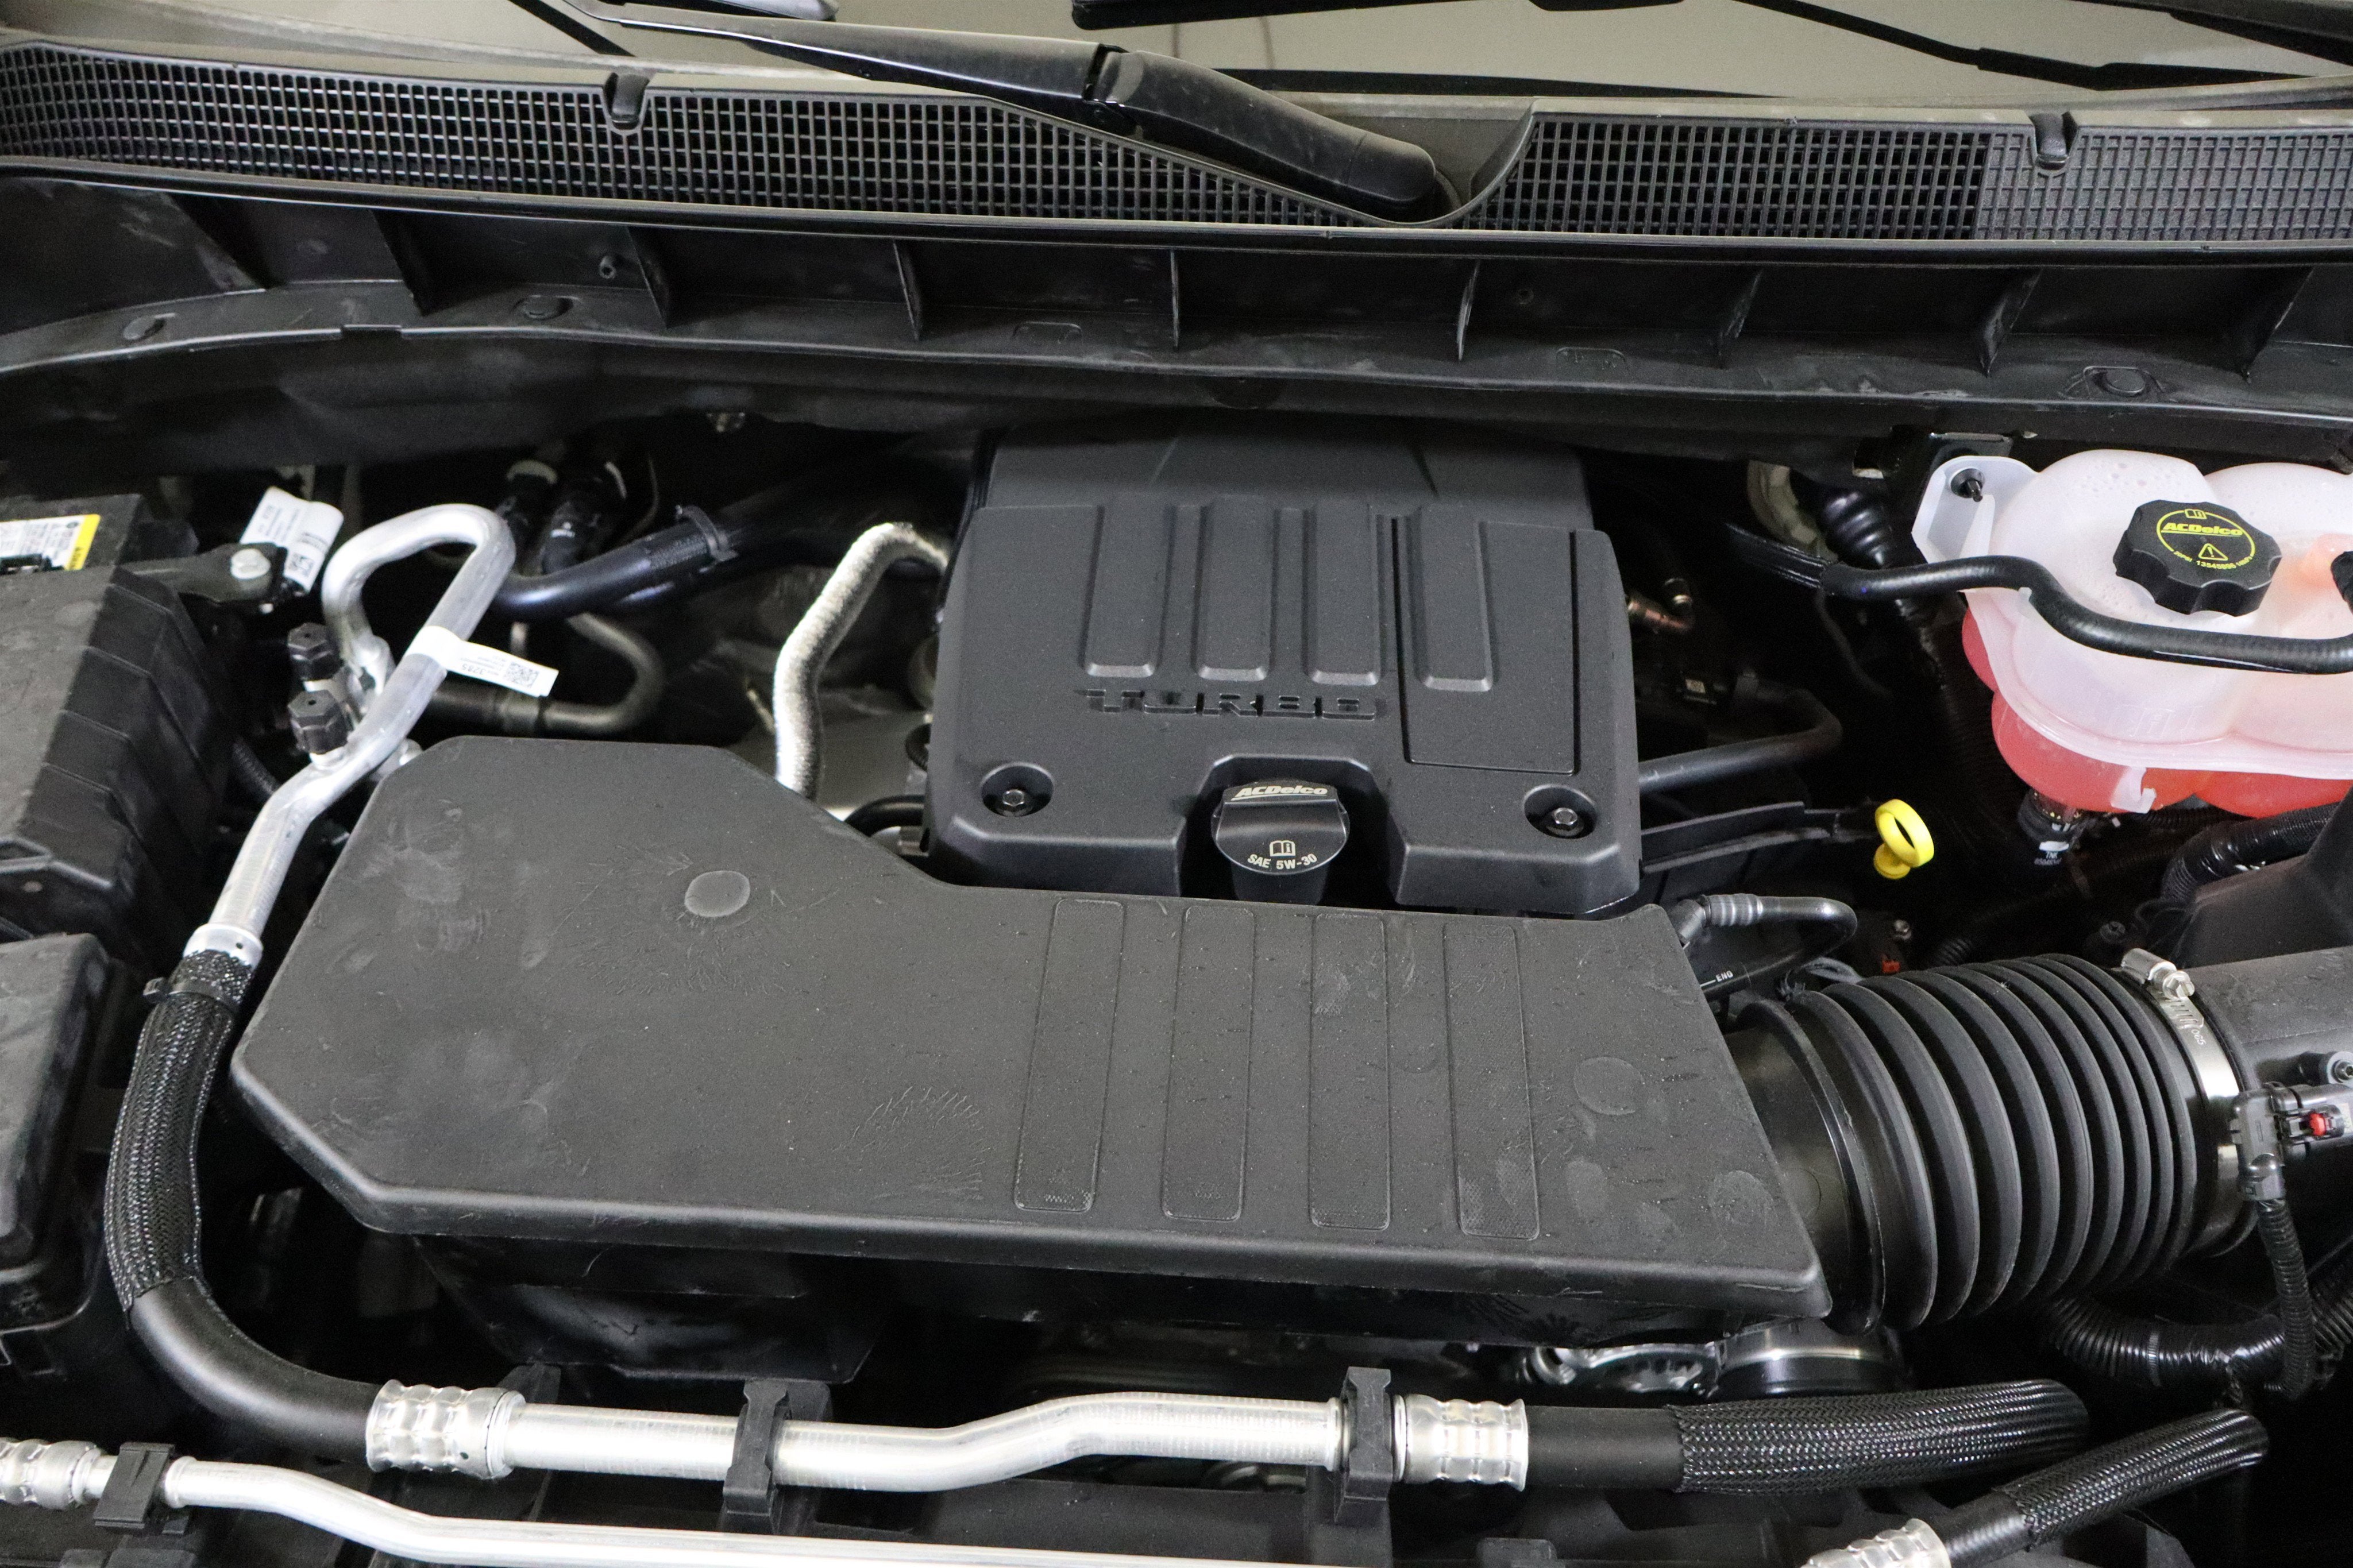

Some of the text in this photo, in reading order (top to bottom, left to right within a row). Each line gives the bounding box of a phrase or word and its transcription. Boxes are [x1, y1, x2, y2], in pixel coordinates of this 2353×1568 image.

[2162, 522, 2243, 536] ACDelco
[1085, 685, 1376, 721] TURBO
[1235, 785, 1328, 798] ACDelco
[1247, 853, 1317, 870] SAE 5W-30
